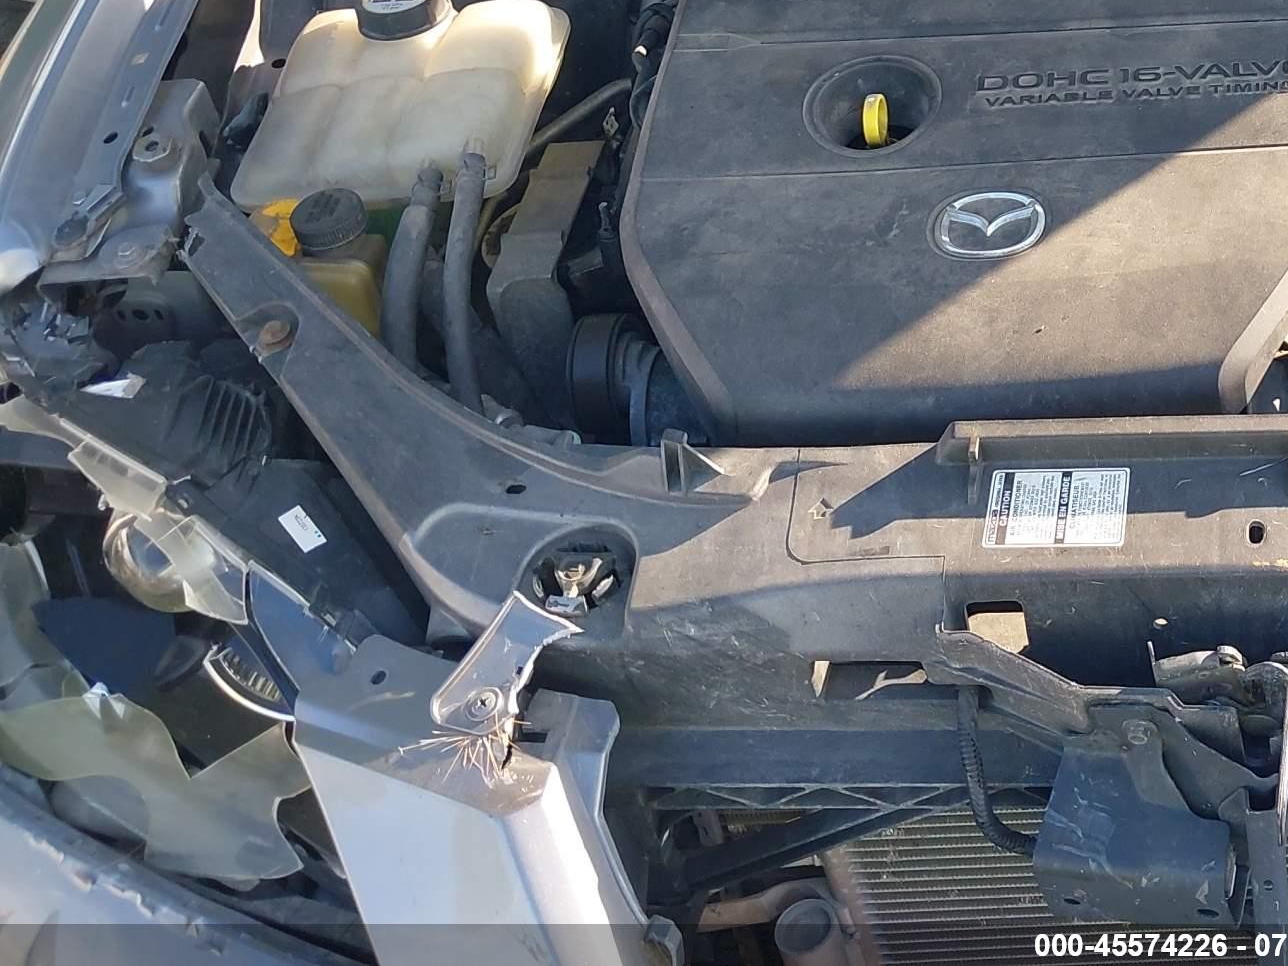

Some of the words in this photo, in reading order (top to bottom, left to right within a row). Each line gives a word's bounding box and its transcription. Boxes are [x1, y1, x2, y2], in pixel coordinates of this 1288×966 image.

[977, 69, 1109, 91] DOHC
[985, 90, 1113, 106] VARIABLE
[1122, 85, 1201, 99] VALVE
[1011, 480, 1022, 522] CONDITIONER
[1060, 476, 1070, 505] GARDE
[999, 491, 1011, 526] CAUTION
[1059, 506, 1067, 518] EN
[1055, 519, 1066, 540] MISE
